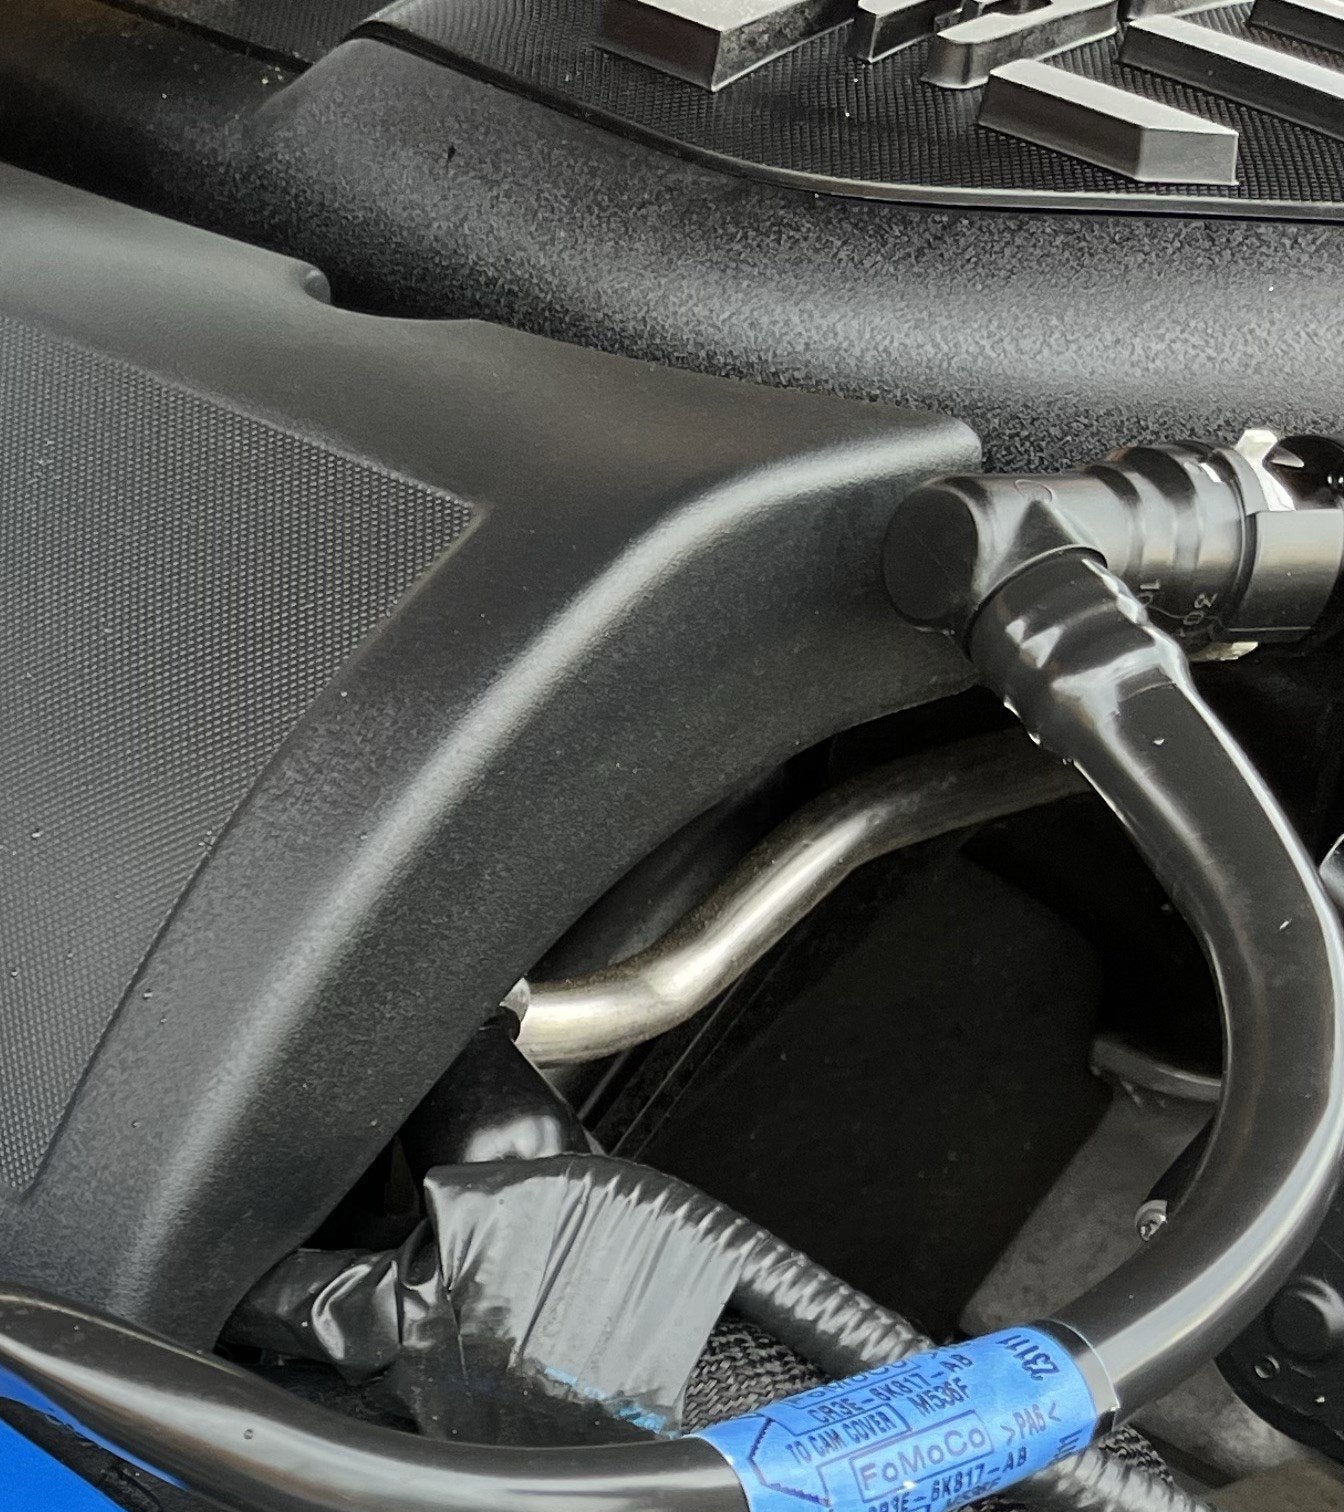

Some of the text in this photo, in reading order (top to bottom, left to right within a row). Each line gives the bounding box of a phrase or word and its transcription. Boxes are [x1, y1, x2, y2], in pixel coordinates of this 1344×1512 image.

[785, 1410, 898, 1466] TO CAM COVER
[858, 1425, 989, 1492] FoMoCo
